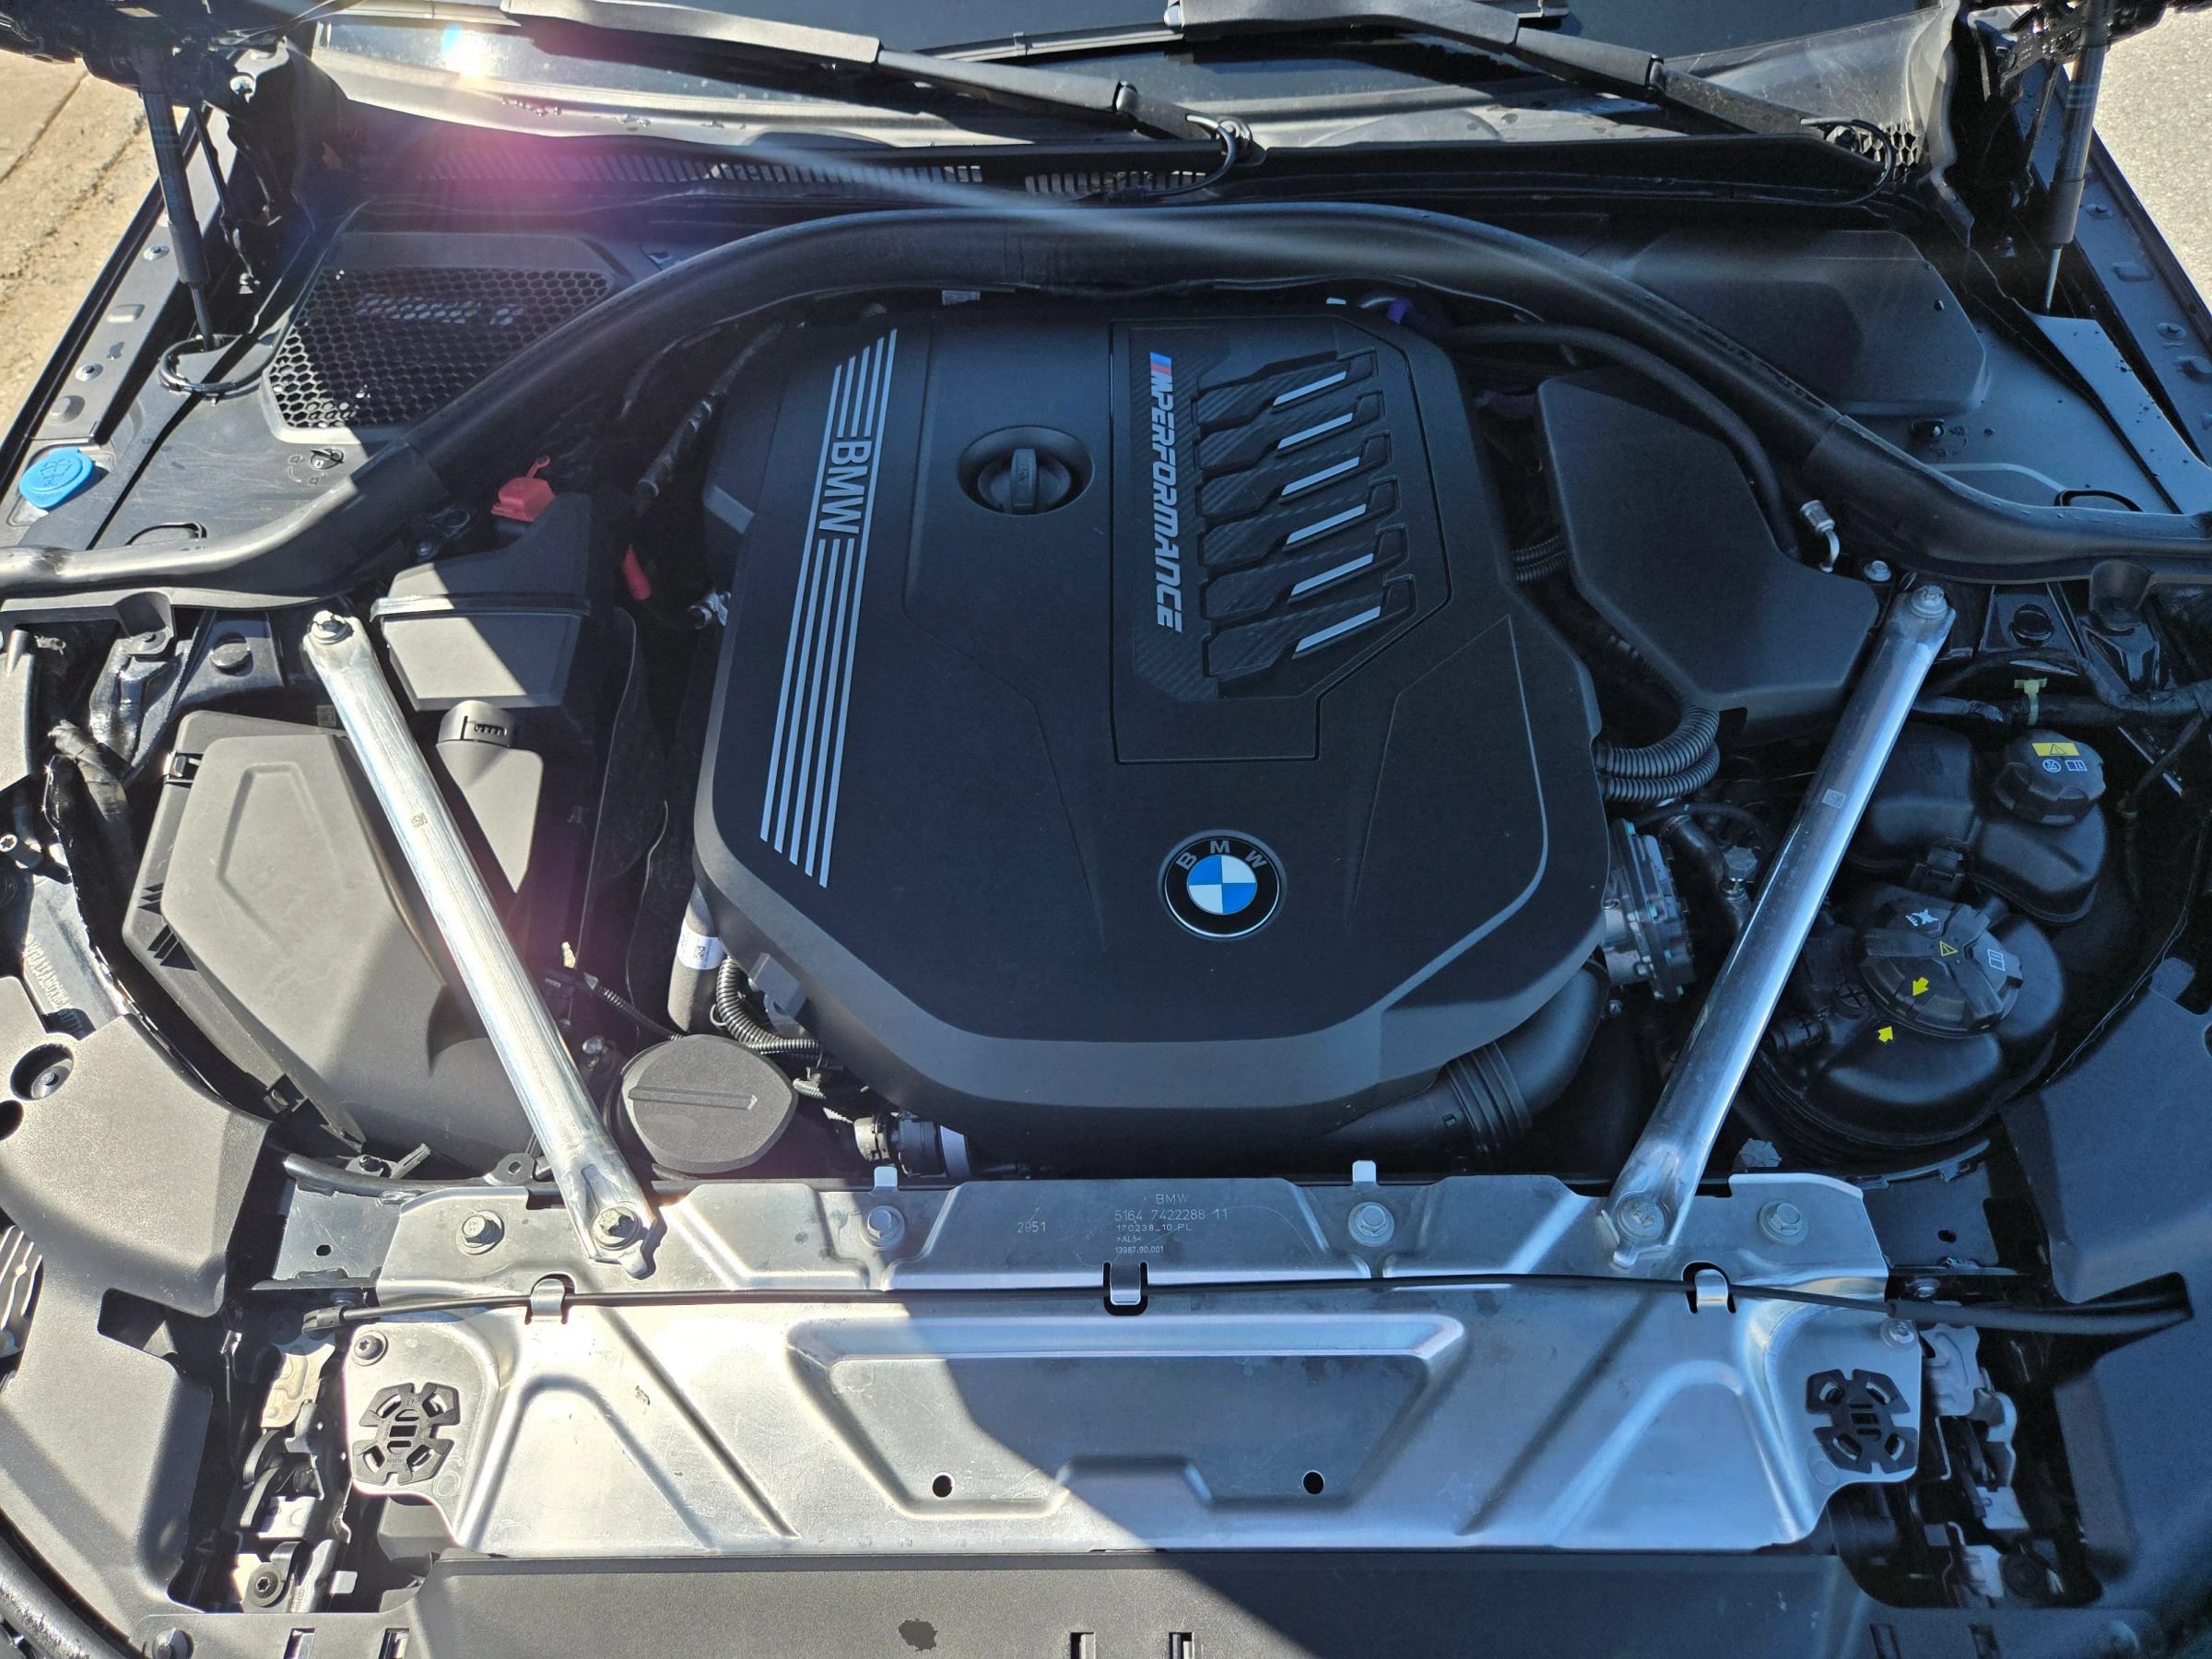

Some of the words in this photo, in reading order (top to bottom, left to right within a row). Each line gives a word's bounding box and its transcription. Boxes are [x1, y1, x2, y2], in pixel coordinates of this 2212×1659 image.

[818, 441, 872, 535] BMW
[1151, 391, 1182, 634] PERFORMANCE
[1175, 840, 1268, 871] BMW
[1156, 1194, 1189, 1204] BMW
[1113, 1209, 1143, 1222] 5164
[1151, 1208, 1206, 1221] 7422288
[1214, 1208, 1229, 1220] 11
[1017, 1221, 1047, 1233] 2951
[1177, 1223, 1192, 1231] PL
